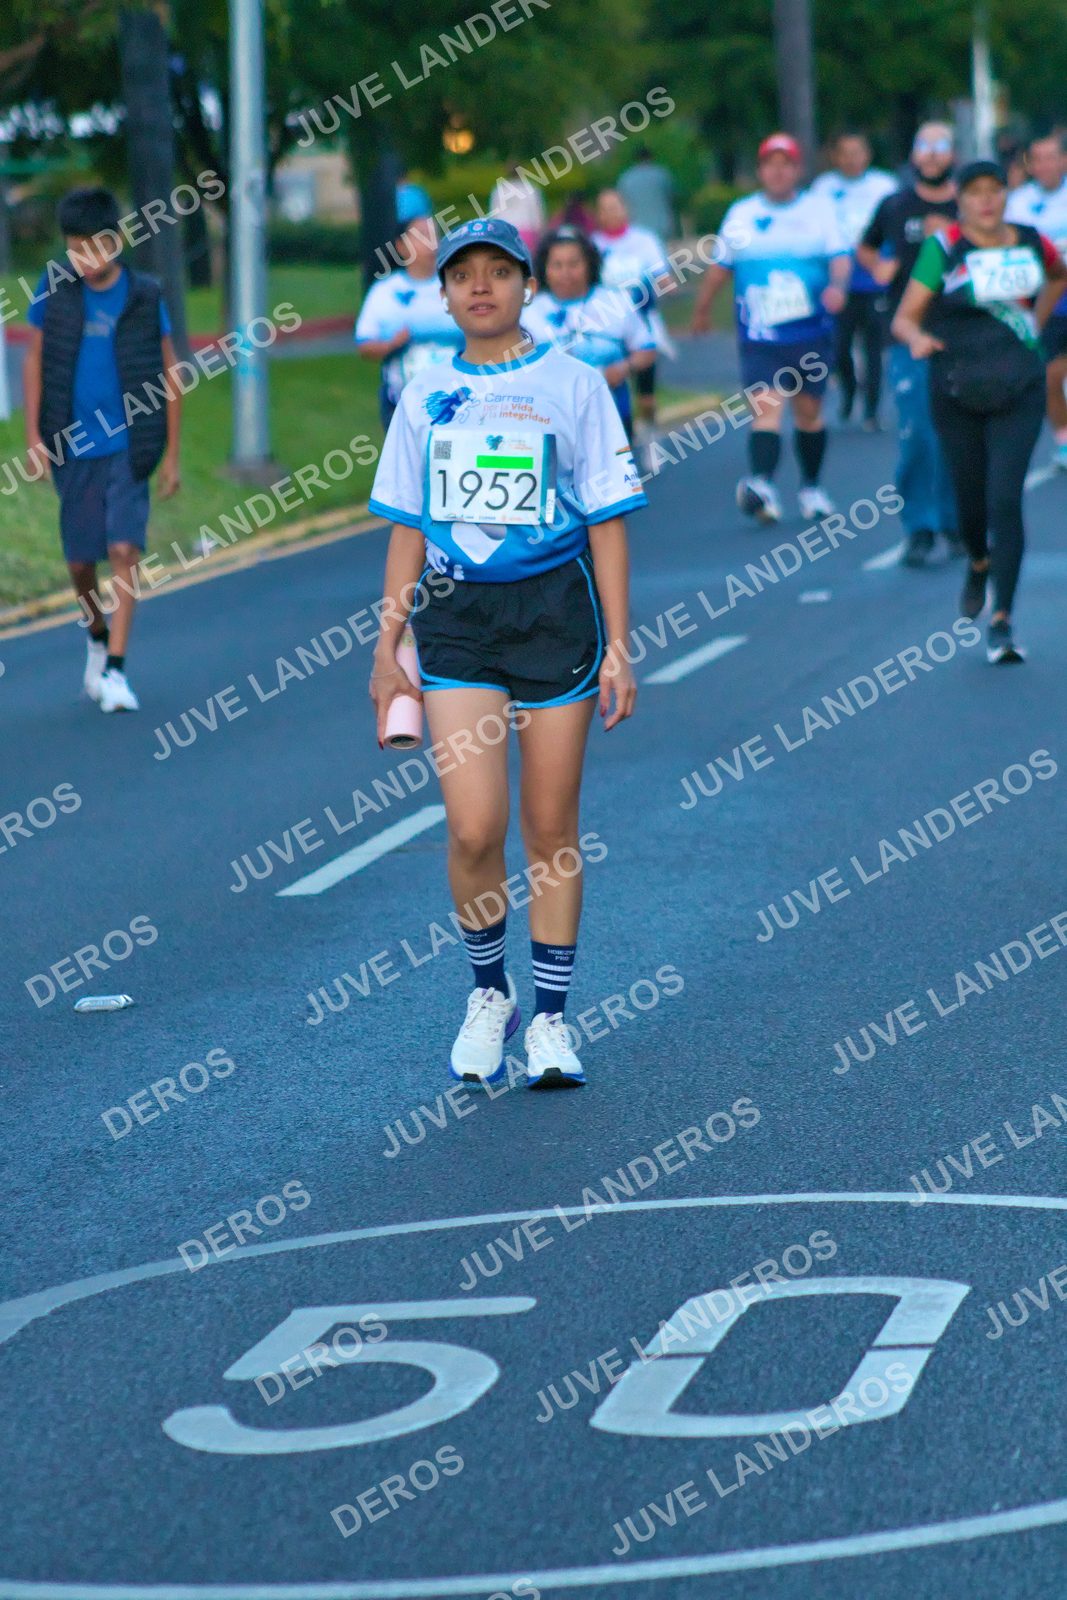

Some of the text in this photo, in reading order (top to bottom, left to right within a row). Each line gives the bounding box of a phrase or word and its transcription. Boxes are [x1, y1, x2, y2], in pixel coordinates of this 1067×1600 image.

[484, 392, 534, 404] Carrera
[511, 403, 533, 412] Vida
[437, 469, 537, 511] 1952
[163, 1277, 970, 1454] 50
